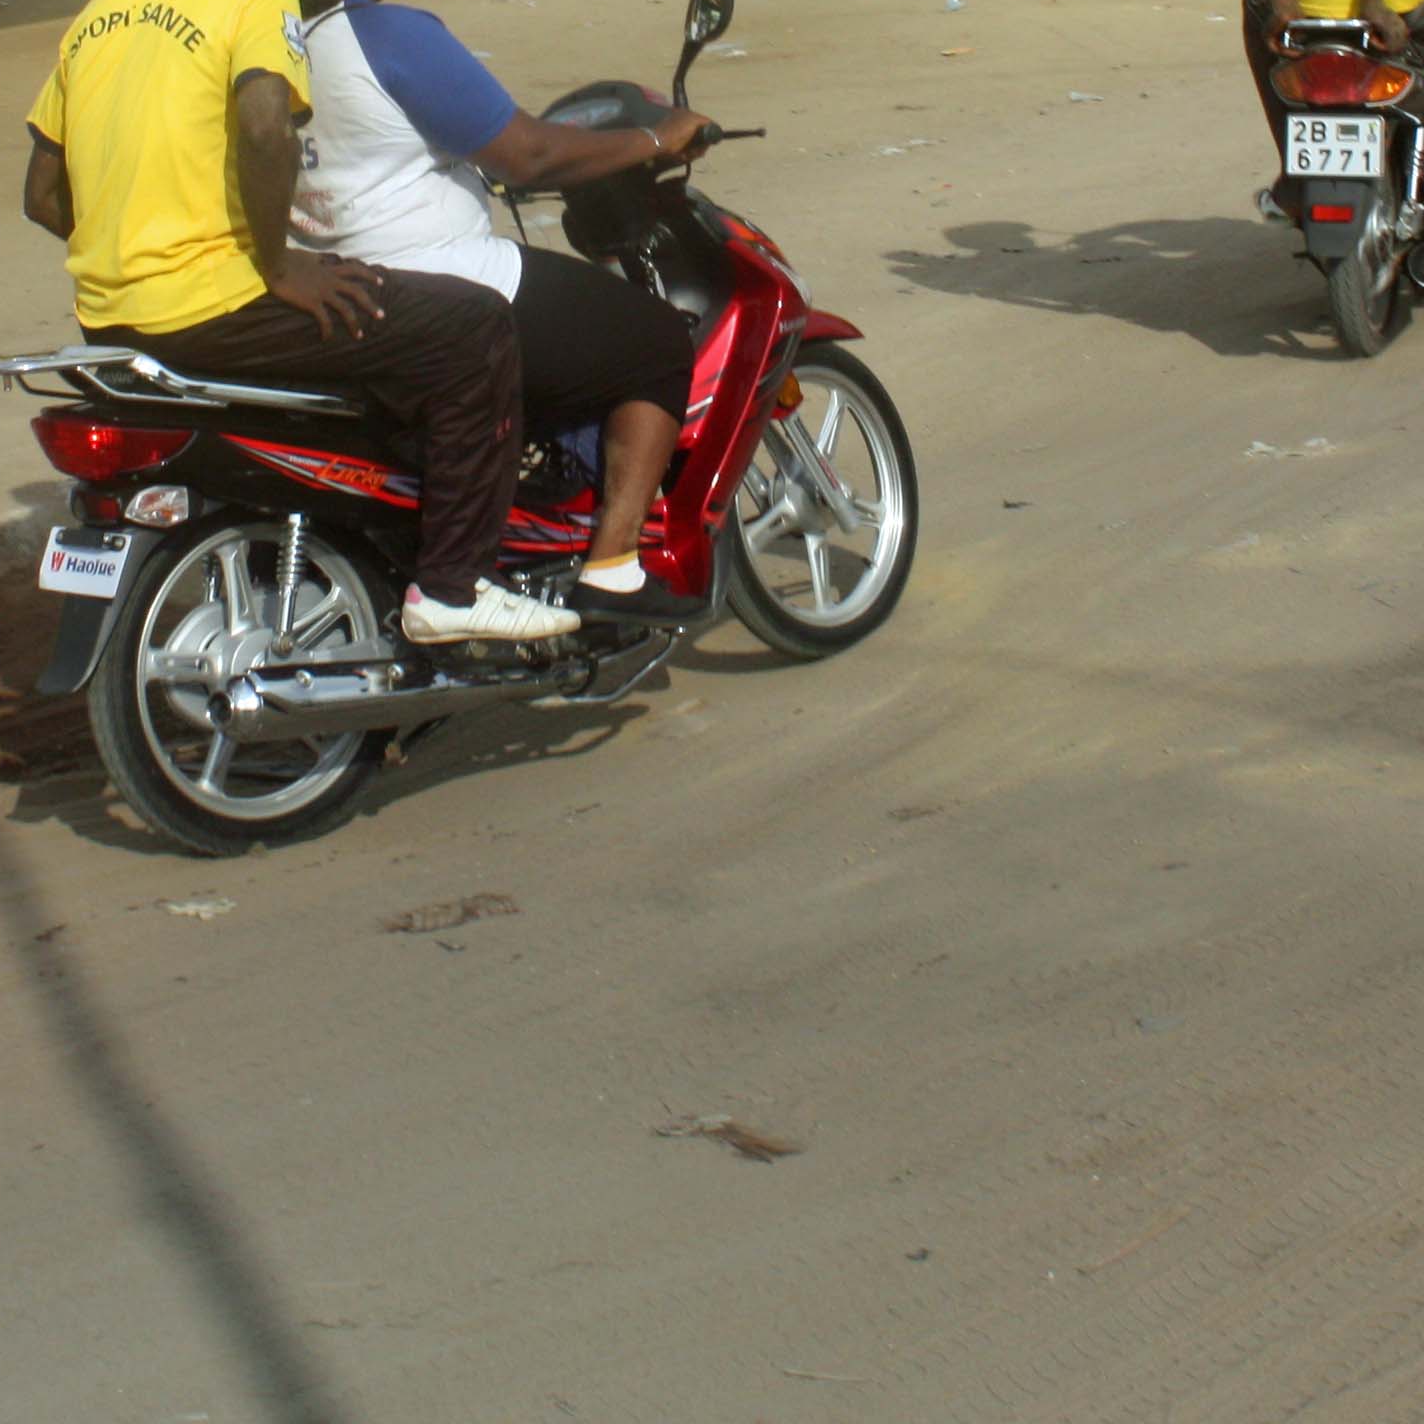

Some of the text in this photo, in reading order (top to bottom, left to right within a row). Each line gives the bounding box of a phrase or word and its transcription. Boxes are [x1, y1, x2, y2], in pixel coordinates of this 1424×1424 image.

[135, 2, 207, 54] SANTE
[1293, 120, 1327, 144] 2B
[1297, 149, 1372, 173] 6771
